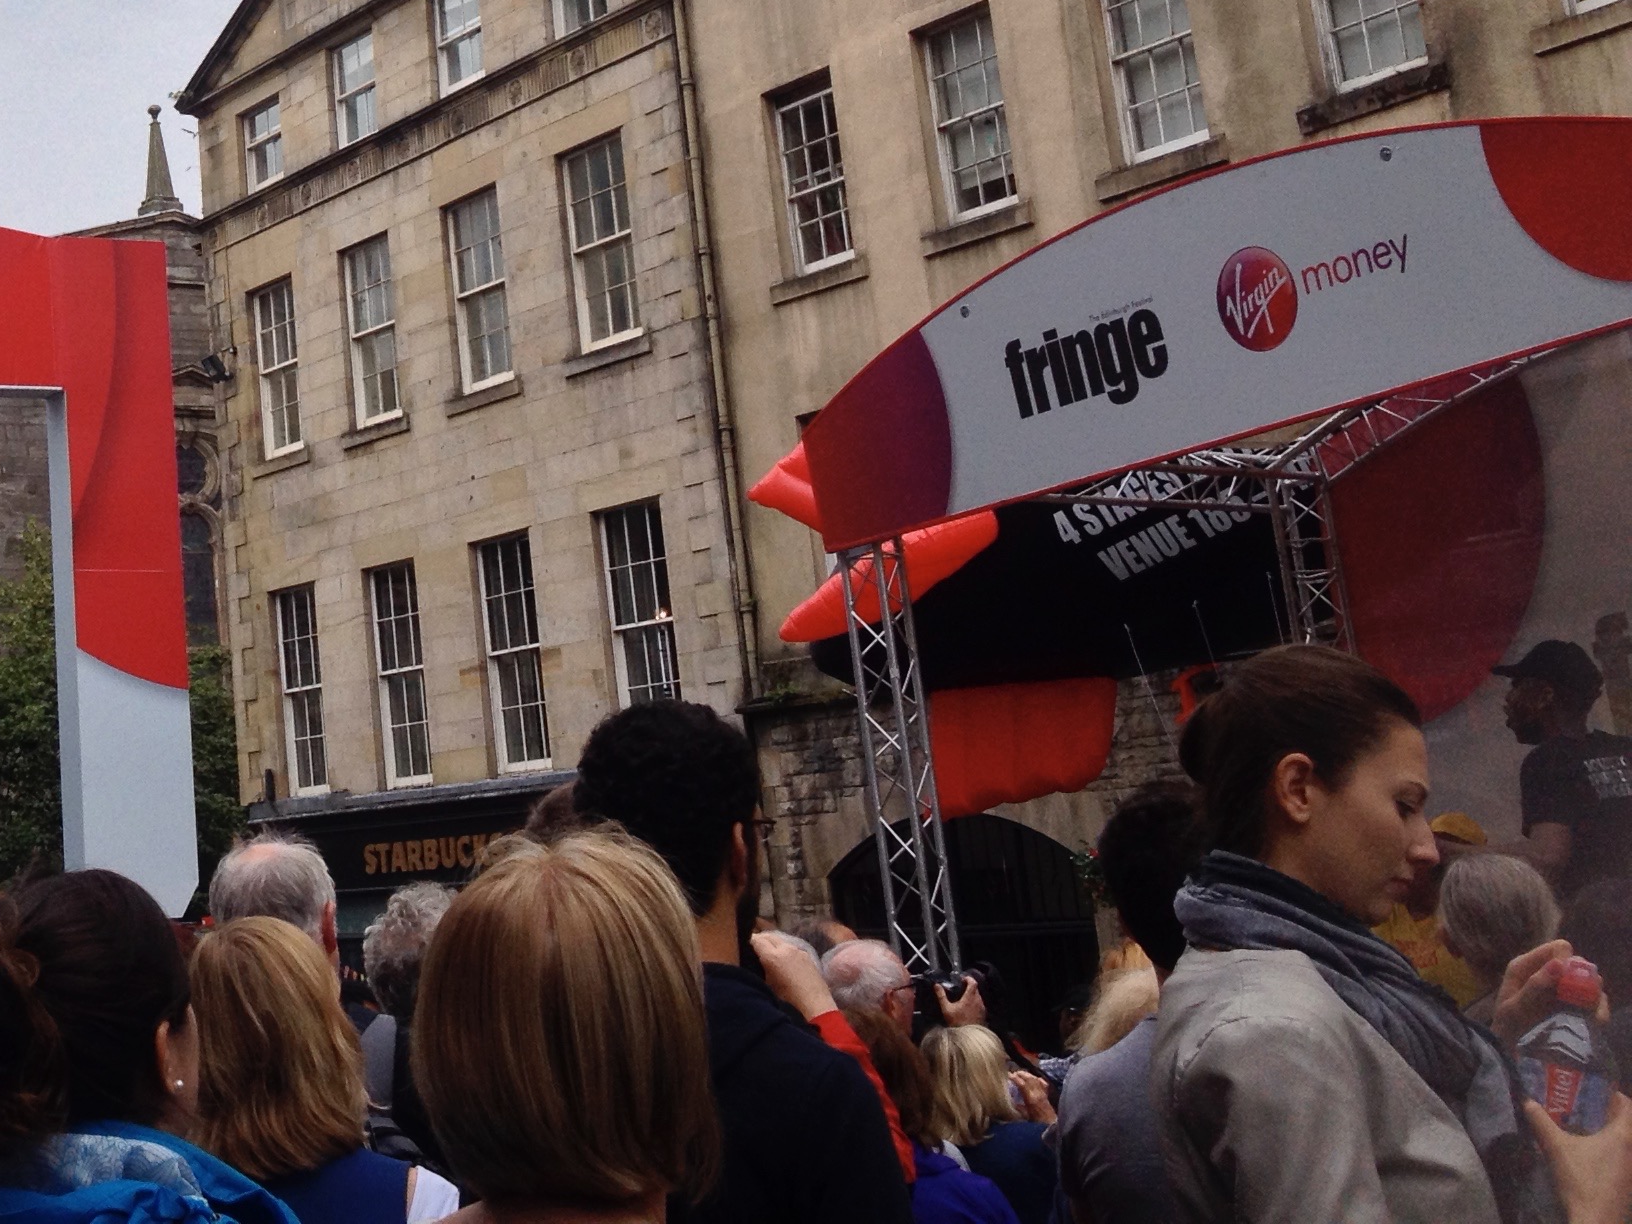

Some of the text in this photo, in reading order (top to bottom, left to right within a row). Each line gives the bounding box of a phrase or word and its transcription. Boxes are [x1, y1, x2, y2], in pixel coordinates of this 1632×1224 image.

[1226, 234, 1408, 339] Virgin money
[1004, 308, 1169, 419] fringe
[1053, 510, 1082, 545] 4
[1072, 461, 1185, 536] STAGES
[1097, 514, 1198, 581] VENUE
[1548, 1068, 1573, 1113] Vittel
